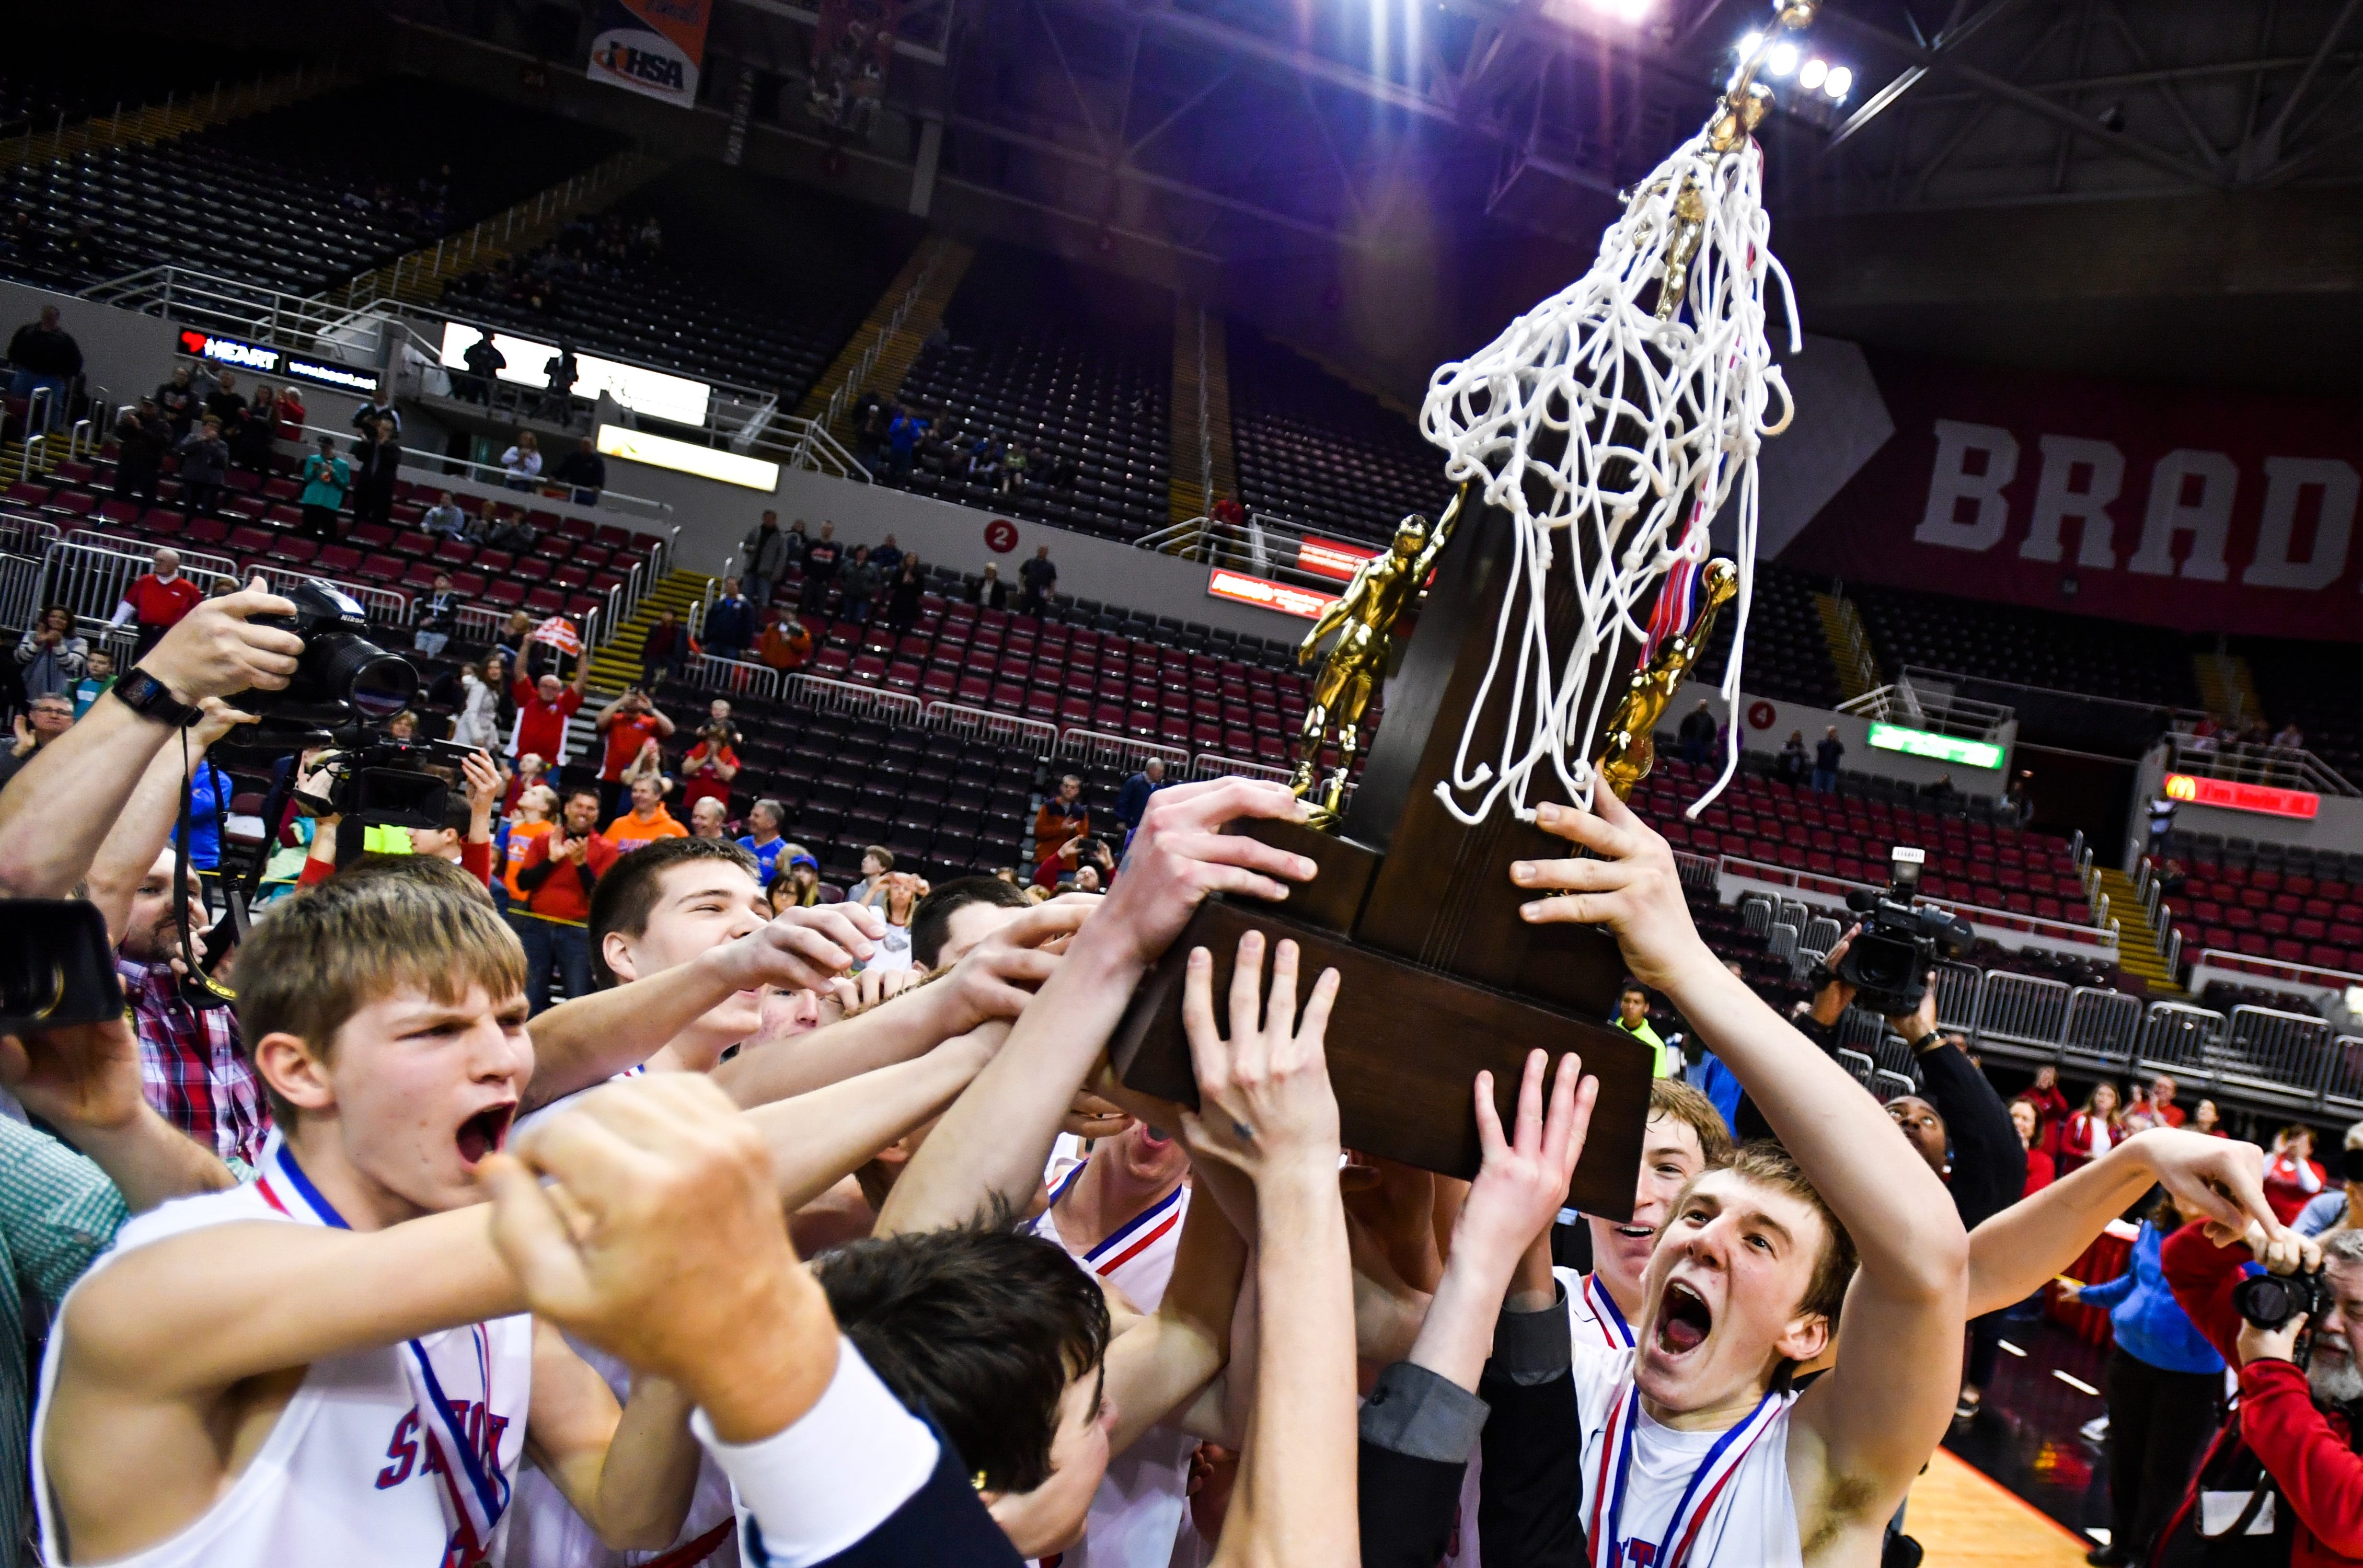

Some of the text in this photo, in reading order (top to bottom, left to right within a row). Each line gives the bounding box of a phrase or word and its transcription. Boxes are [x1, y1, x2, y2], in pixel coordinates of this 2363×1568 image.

[204, 337, 279, 369] HEART
[1914, 418, 2363, 592] BRAD
[994, 527, 1009, 545] 2
[340, 614, 365, 624] Nikon
[1756, 707, 1768, 723] 4
